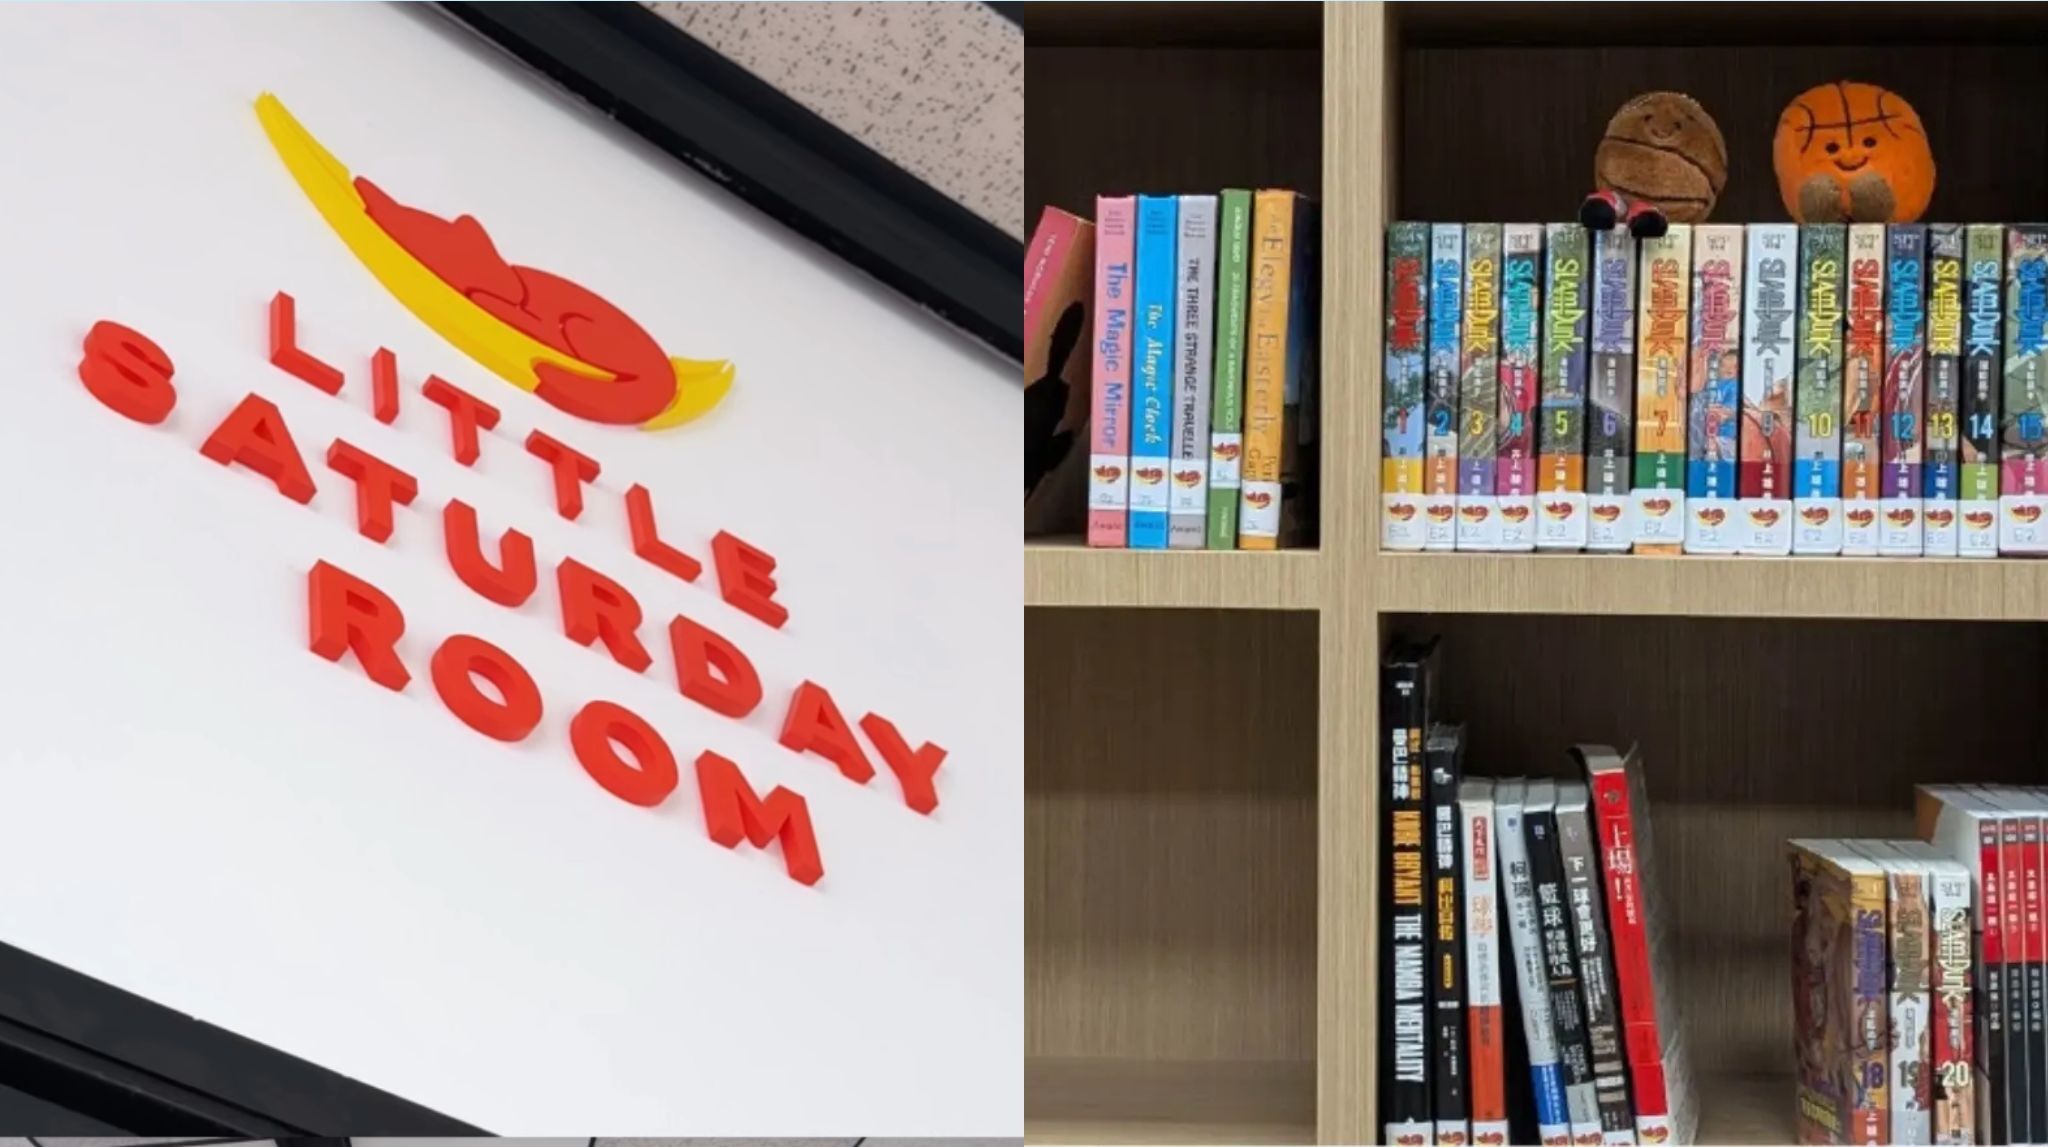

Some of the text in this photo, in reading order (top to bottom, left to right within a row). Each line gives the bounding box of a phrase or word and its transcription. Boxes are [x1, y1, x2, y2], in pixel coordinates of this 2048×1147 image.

[1106, 262, 1129, 299] The
[1187, 257, 1201, 285] THE
[1255, 235, 1285, 309] Elegy
[1186, 287, 1200, 330] THREE
[1099, 309, 1129, 371] Magic
[1143, 304, 1164, 445] The Magic Clock
[1184, 332, 1198, 393] STRANGE
[1251, 332, 1279, 436] Easterly
[1103, 382, 1128, 448] Mirror
[1434, 409, 1450, 436] 2
[1470, 409, 1484, 435] 3
[1509, 410, 1524, 437] 4
[1555, 409, 1568, 436] 5
[1602, 410, 1617, 436] 6
[1653, 409, 1668, 437] 7
[1808, 412, 1832, 438] 10
[1853, 412, 1874, 438] 11
[1891, 412, 1916, 439] 12
[1930, 412, 1954, 438] 13
[1970, 413, 1994, 439] 14
[2017, 412, 2043, 439] 15
[269, 290, 789, 629] LITTLE
[78, 320, 948, 815] SATURDAY
[308, 559, 824, 886] ROOM
[1393, 851, 1422, 906] BRYANT
[1394, 913, 1423, 940] THE
[1394, 1004, 1424, 1083] MENTALITY
[1861, 1059, 1885, 1088] 18
[1942, 1059, 1970, 1087] 20
